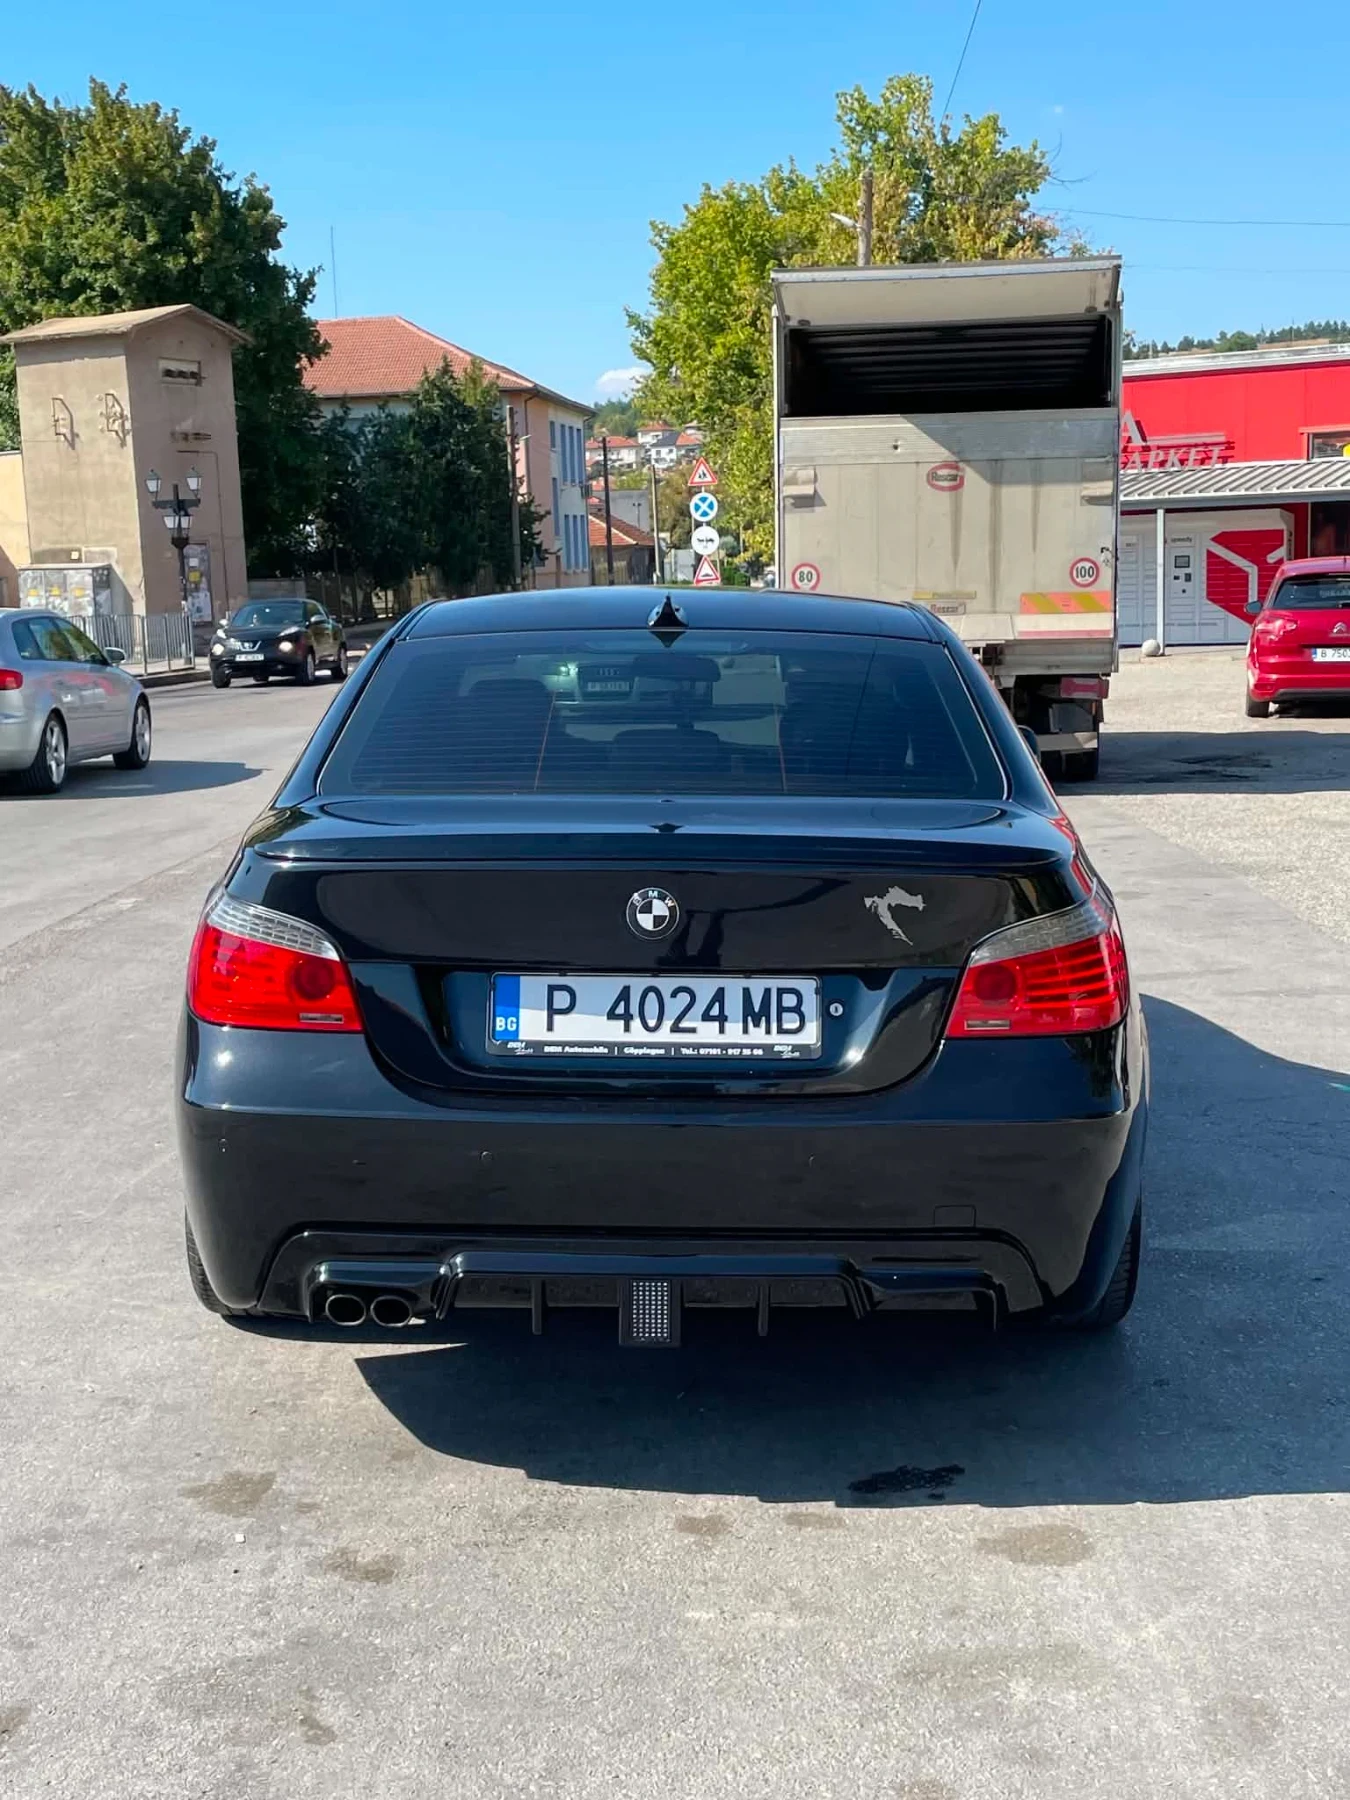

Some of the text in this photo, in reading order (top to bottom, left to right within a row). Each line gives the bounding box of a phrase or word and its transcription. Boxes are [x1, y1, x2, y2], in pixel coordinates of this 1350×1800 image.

[1123, 446, 1226, 472] АРКЕТ
[799, 570, 813, 583] 80
[1076, 565, 1095, 579] 100
[633, 890, 675, 907] BMW
[546, 984, 577, 1032] P
[496, 1016, 518, 1031] BG
